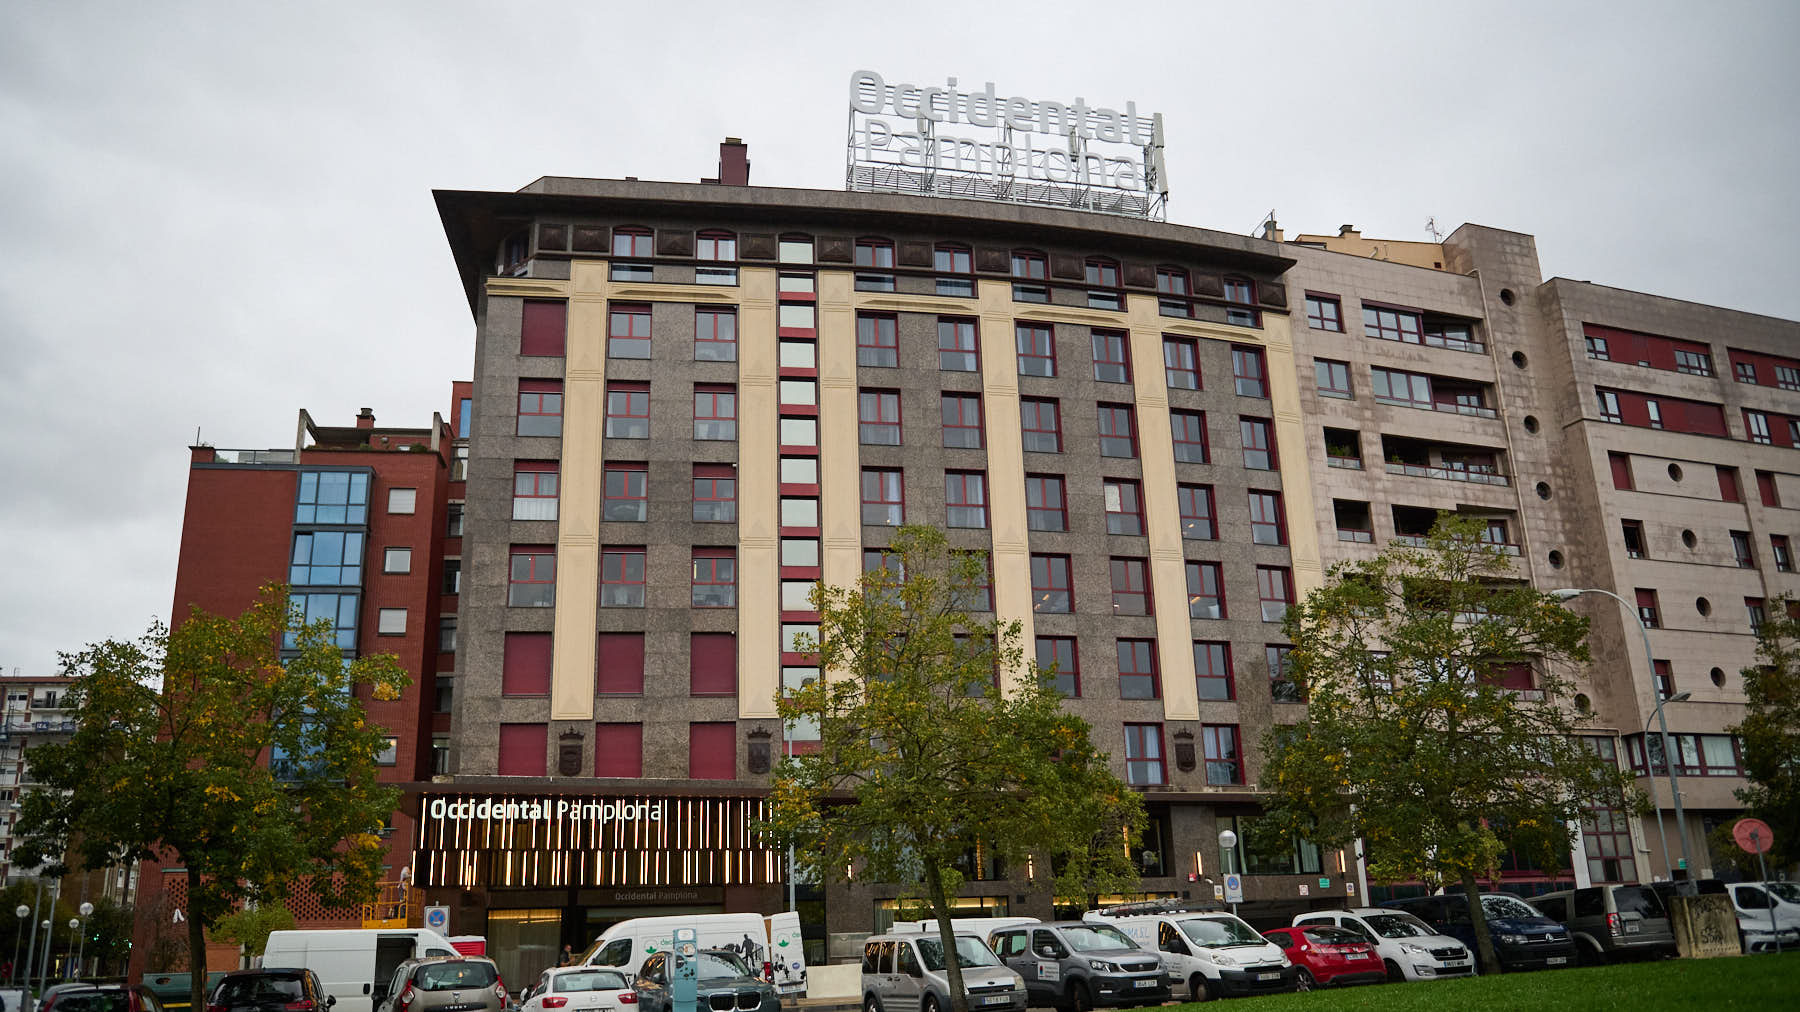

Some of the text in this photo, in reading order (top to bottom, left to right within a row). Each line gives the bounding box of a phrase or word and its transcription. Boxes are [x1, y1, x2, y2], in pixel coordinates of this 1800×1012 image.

[849, 69, 1144, 147] Occidental
[865, 118, 1139, 191] Pamplona
[430, 799, 662, 824] Occidental Pamplona
[615, 891, 698, 902] Occidental Pamplona
